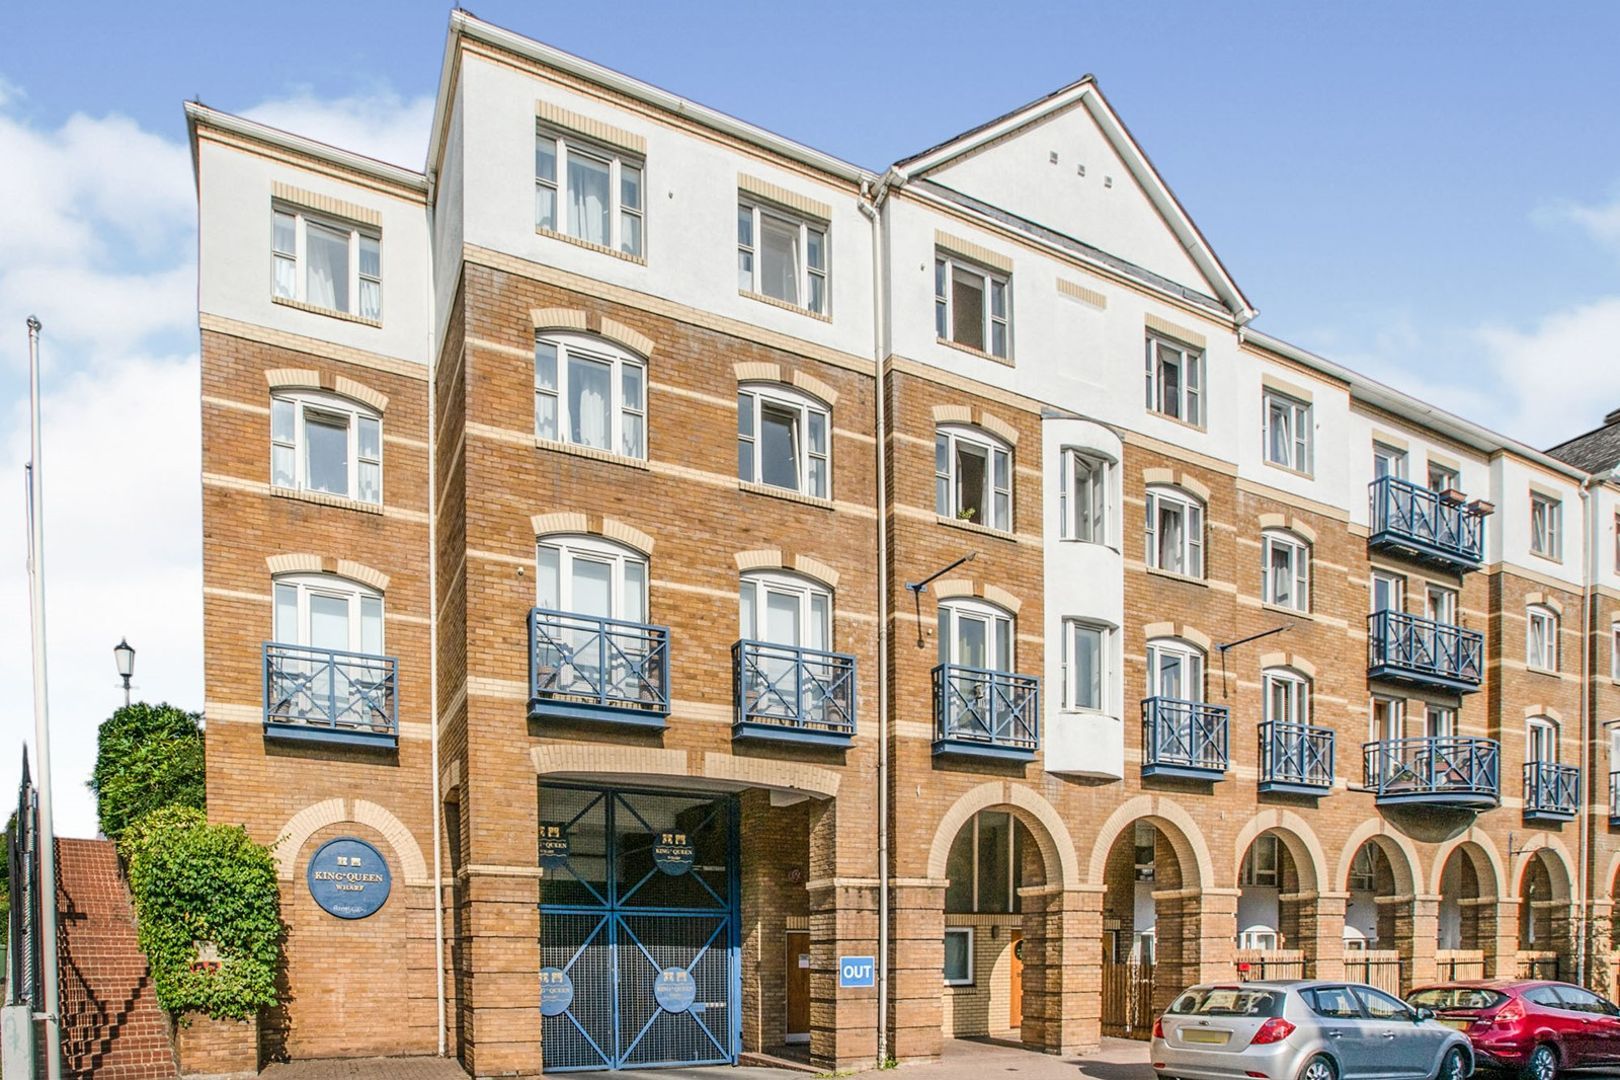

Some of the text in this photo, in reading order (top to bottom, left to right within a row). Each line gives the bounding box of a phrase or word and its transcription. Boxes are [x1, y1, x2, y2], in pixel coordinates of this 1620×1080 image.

[314, 871, 383, 882] KING QUEEN
[843, 965, 872, 978] OUT
